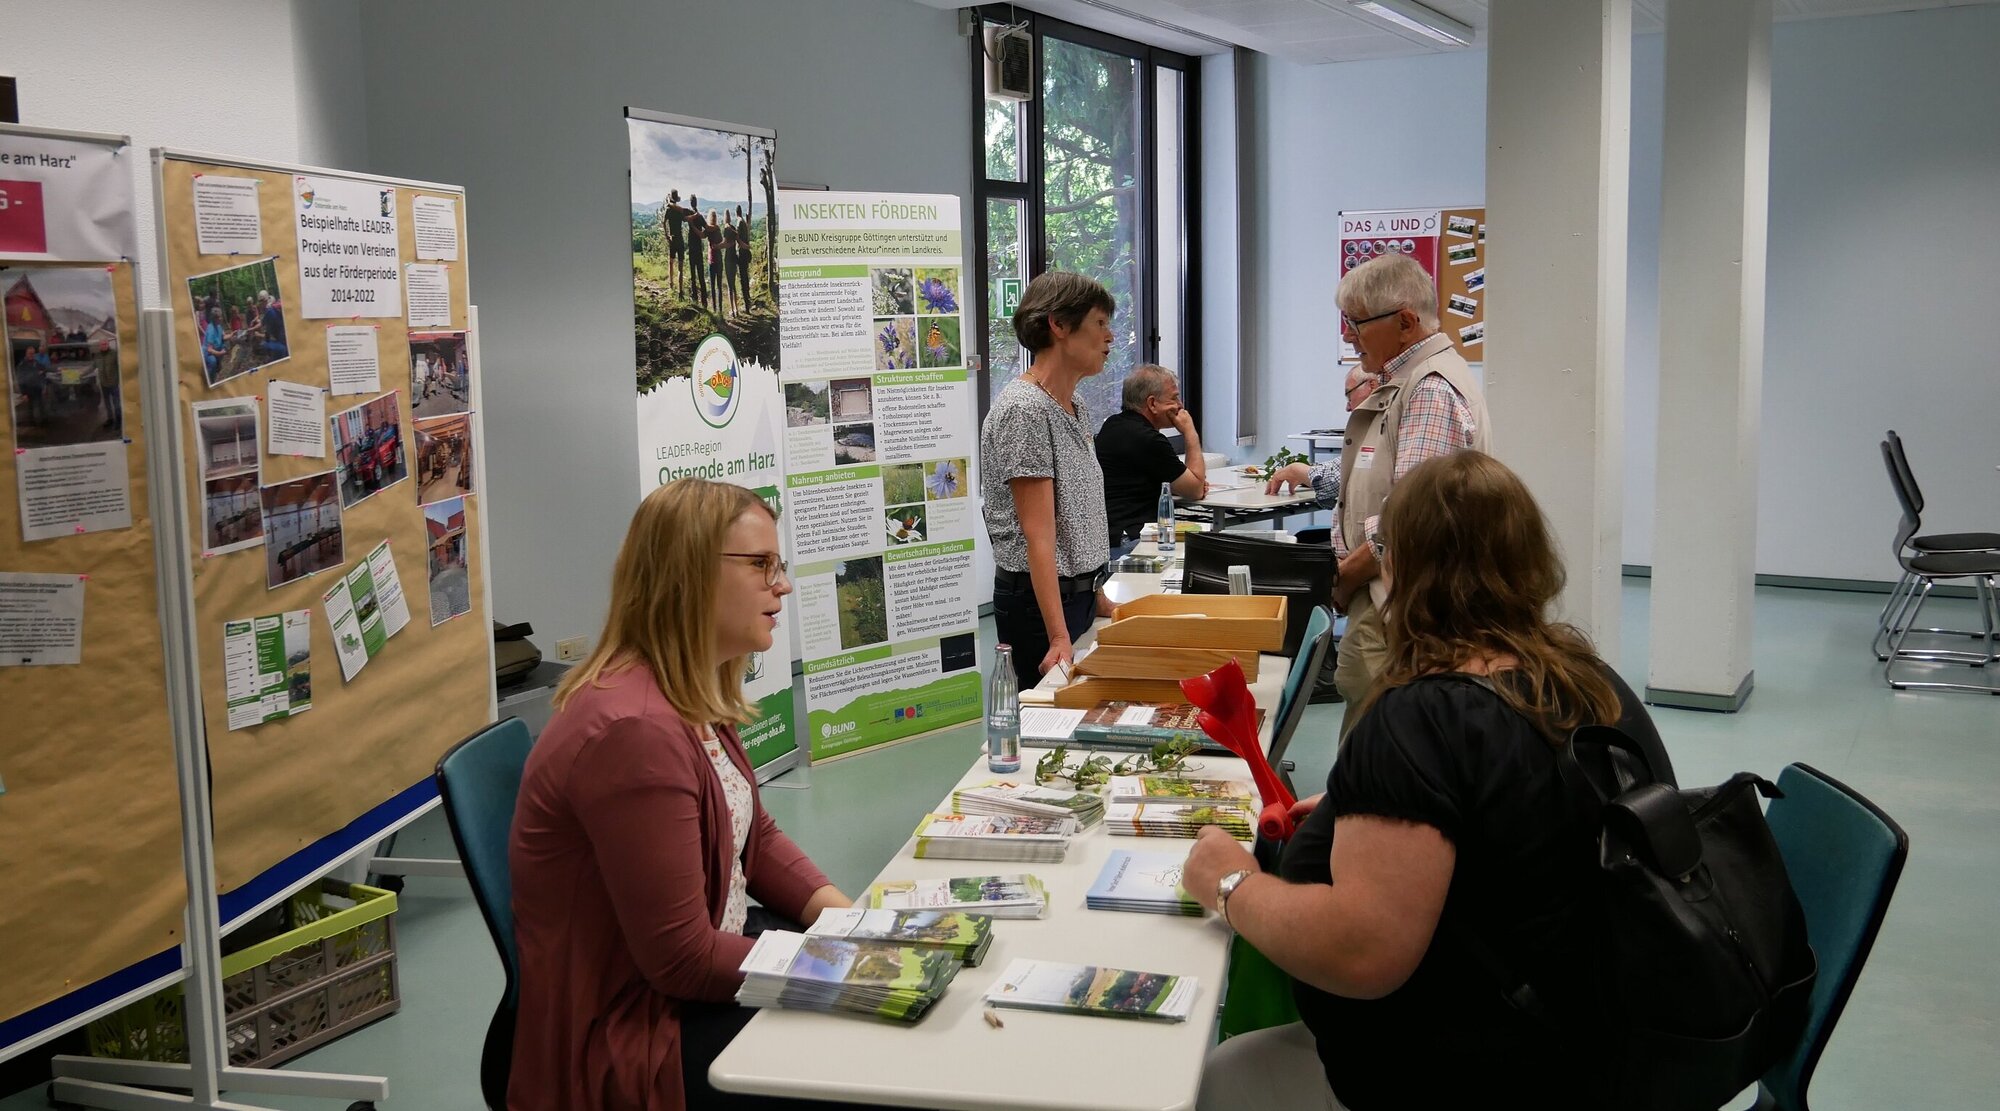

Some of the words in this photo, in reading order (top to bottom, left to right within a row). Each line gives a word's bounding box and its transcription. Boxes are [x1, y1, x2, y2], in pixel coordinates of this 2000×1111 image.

[14, 154, 36, 166] am
[40, 154, 76, 168] Harz"
[793, 204, 865, 219] INSEKTEN
[872, 200, 937, 220] FÖRDERN
[301, 214, 359, 232] Beispielhafte
[362, 219, 394, 234] LEADER-
[1344, 220, 1371, 232] DAS
[1376, 220, 1386, 231] A
[1391, 219, 1420, 231] UND
[798, 234, 819, 242] BUND
[821, 234, 861, 244] Kreisgruppe
[864, 233, 896, 244] Göttingen
[302, 239, 340, 256] Projekte
[343, 245, 358, 255] von
[360, 242, 396, 257] Vereinen
[791, 246, 809, 255] berät
[812, 246, 855, 254] verschiedene
[304, 267, 320, 278] aus
[323, 264, 337, 278] der
[340, 265, 397, 281] Förderperiode
[332, 289, 374, 302] 2014-2022
[877, 375, 913, 383] Strukturen
[915, 372, 943, 380] schaffen
[656, 441, 722, 460] LEADER-Region
[659, 458, 723, 485] Osterode
[728, 458, 745, 475] am
[749, 452, 775, 471] Harz
[792, 476, 823, 485] Nahrung
[826, 472, 856, 481] anbieten
[888, 548, 940, 560] Bewirtschaftung
[943, 544, 963, 552] ändern
[808, 655, 855, 672] Grundsätzlich
[738, 720, 768, 737] nformationen
[832, 721, 856, 734] BUND
